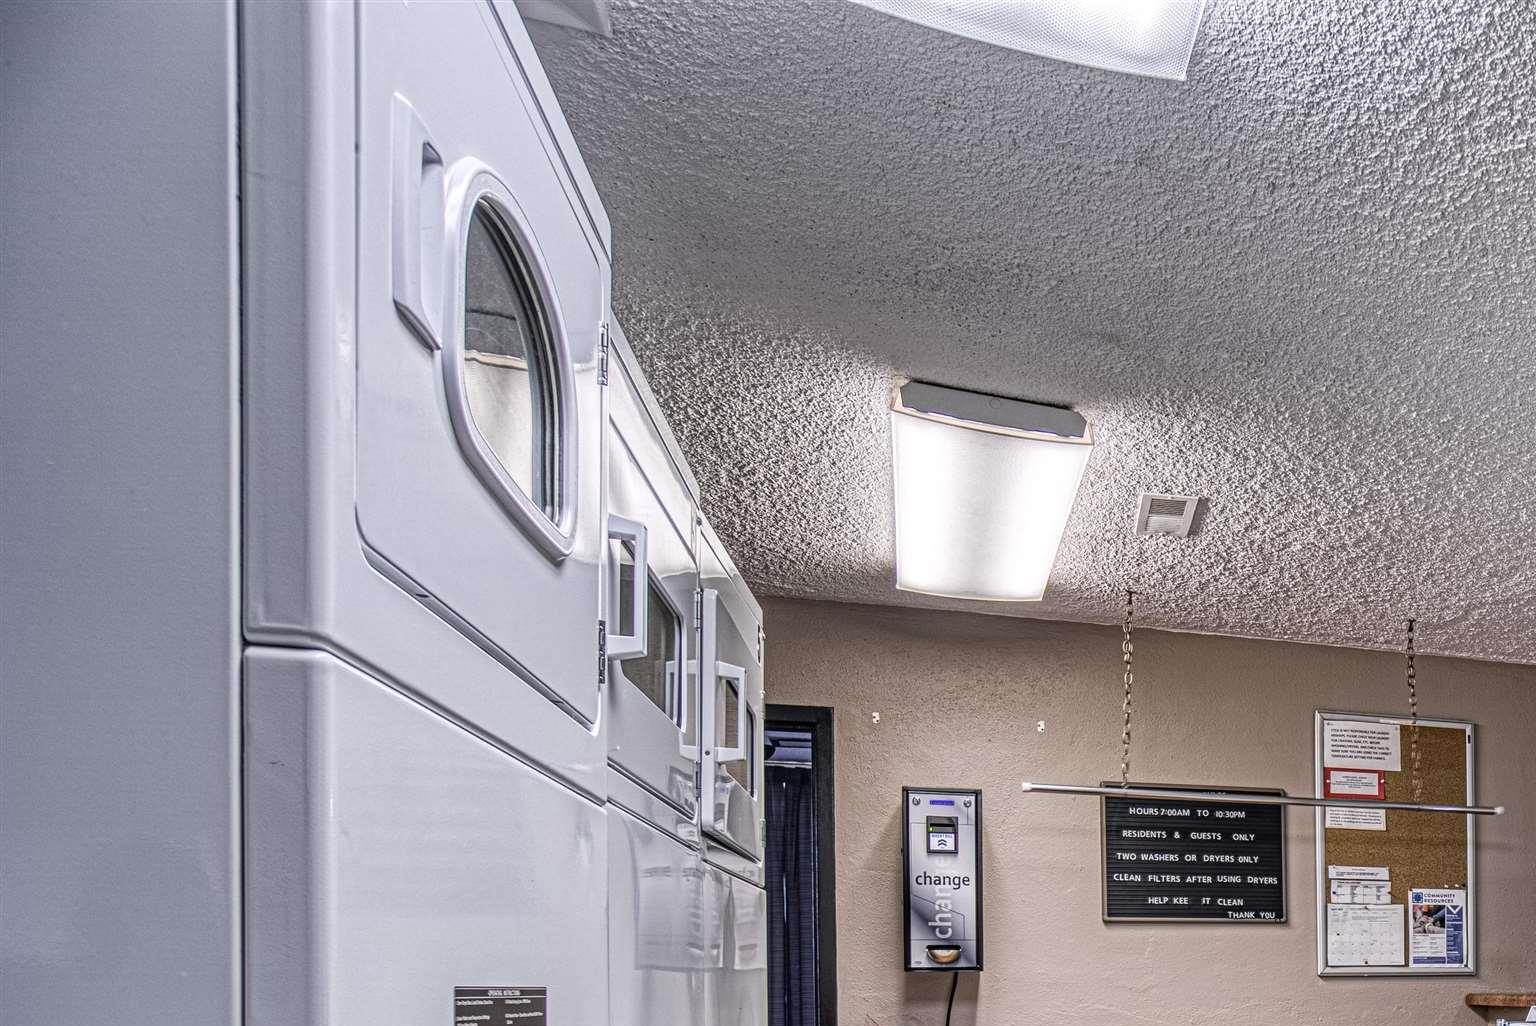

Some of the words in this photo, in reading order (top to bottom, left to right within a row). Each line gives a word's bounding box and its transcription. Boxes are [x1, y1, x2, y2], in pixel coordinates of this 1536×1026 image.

[1129, 807, 1159, 816] HOURS
[1160, 808, 1190, 816] 7:00AM
[1197, 809, 1209, 817] TO
[1215, 810, 1246, 819] 10:30PM
[1122, 830, 1167, 839] RESIDENTS
[1174, 831, 1181, 839] &
[1190, 832, 1222, 840] GUESTS
[1232, 833, 1255, 842] ONLY
[1116, 852, 1137, 861] TWO
[1140, 853, 1179, 862] WASHERS
[1184, 854, 1197, 862] OR
[1203, 854, 1235, 863] DRYERS
[1238, 855, 1259, 864] ONLY
[915, 871, 970, 890] change
[1113, 873, 1141, 882] CLEAN
[1148, 874, 1181, 883] FILTERS
[1186, 875, 1212, 884] AFTER
[1217, 875, 1241, 883] USING
[1247, 876, 1278, 885] DRYERS
[1148, 896, 1168, 905] HELP
[1173, 897, 1189, 905] KEE
[1202, 897, 1211, 905] IT
[1217, 898, 1244, 906] CLEAN
[1228, 911, 1255, 919] THANK
[1259, 911, 1276, 920] YOU
